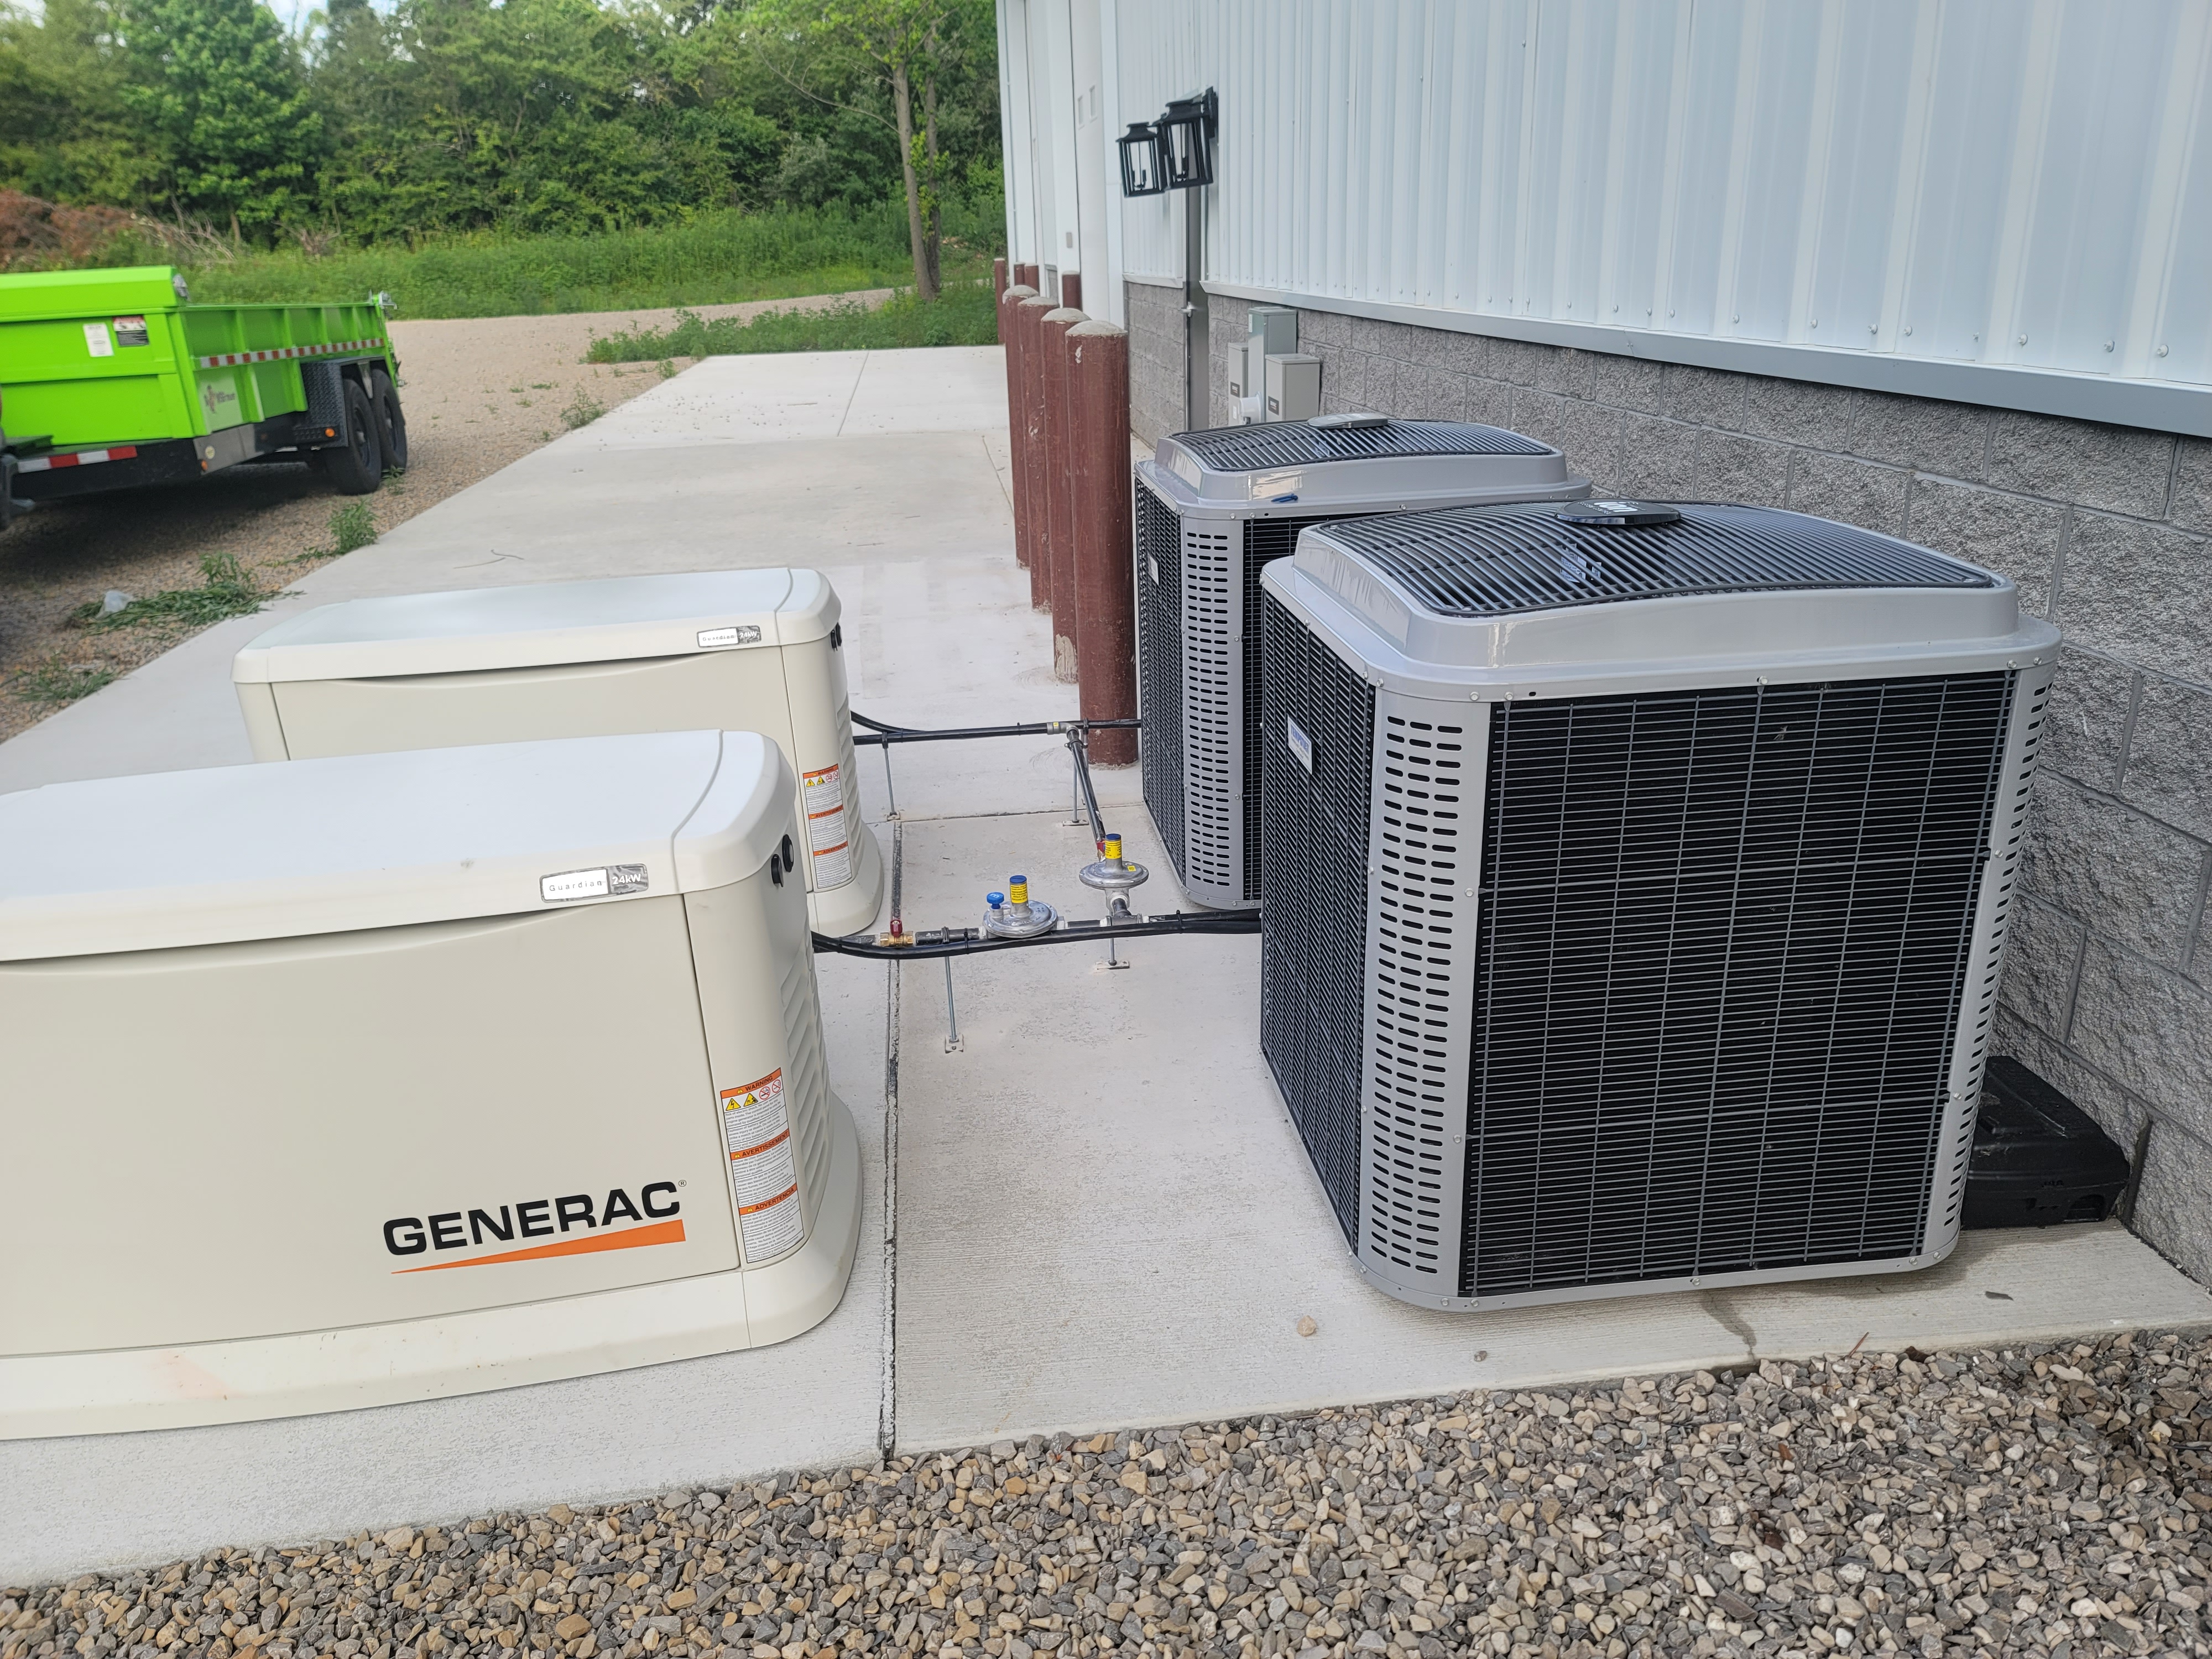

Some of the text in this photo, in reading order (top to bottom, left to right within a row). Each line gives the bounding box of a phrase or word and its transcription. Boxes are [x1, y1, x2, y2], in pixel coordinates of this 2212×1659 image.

[549, 873, 641, 891] Guardian 24kW
[745, 1076, 773, 1091] WARNING
[742, 1131, 788, 1157] AVERTISSEMENT
[755, 1188, 794, 1211] ADVERTENCIA
[383, 1181, 680, 1256] GENERAC
